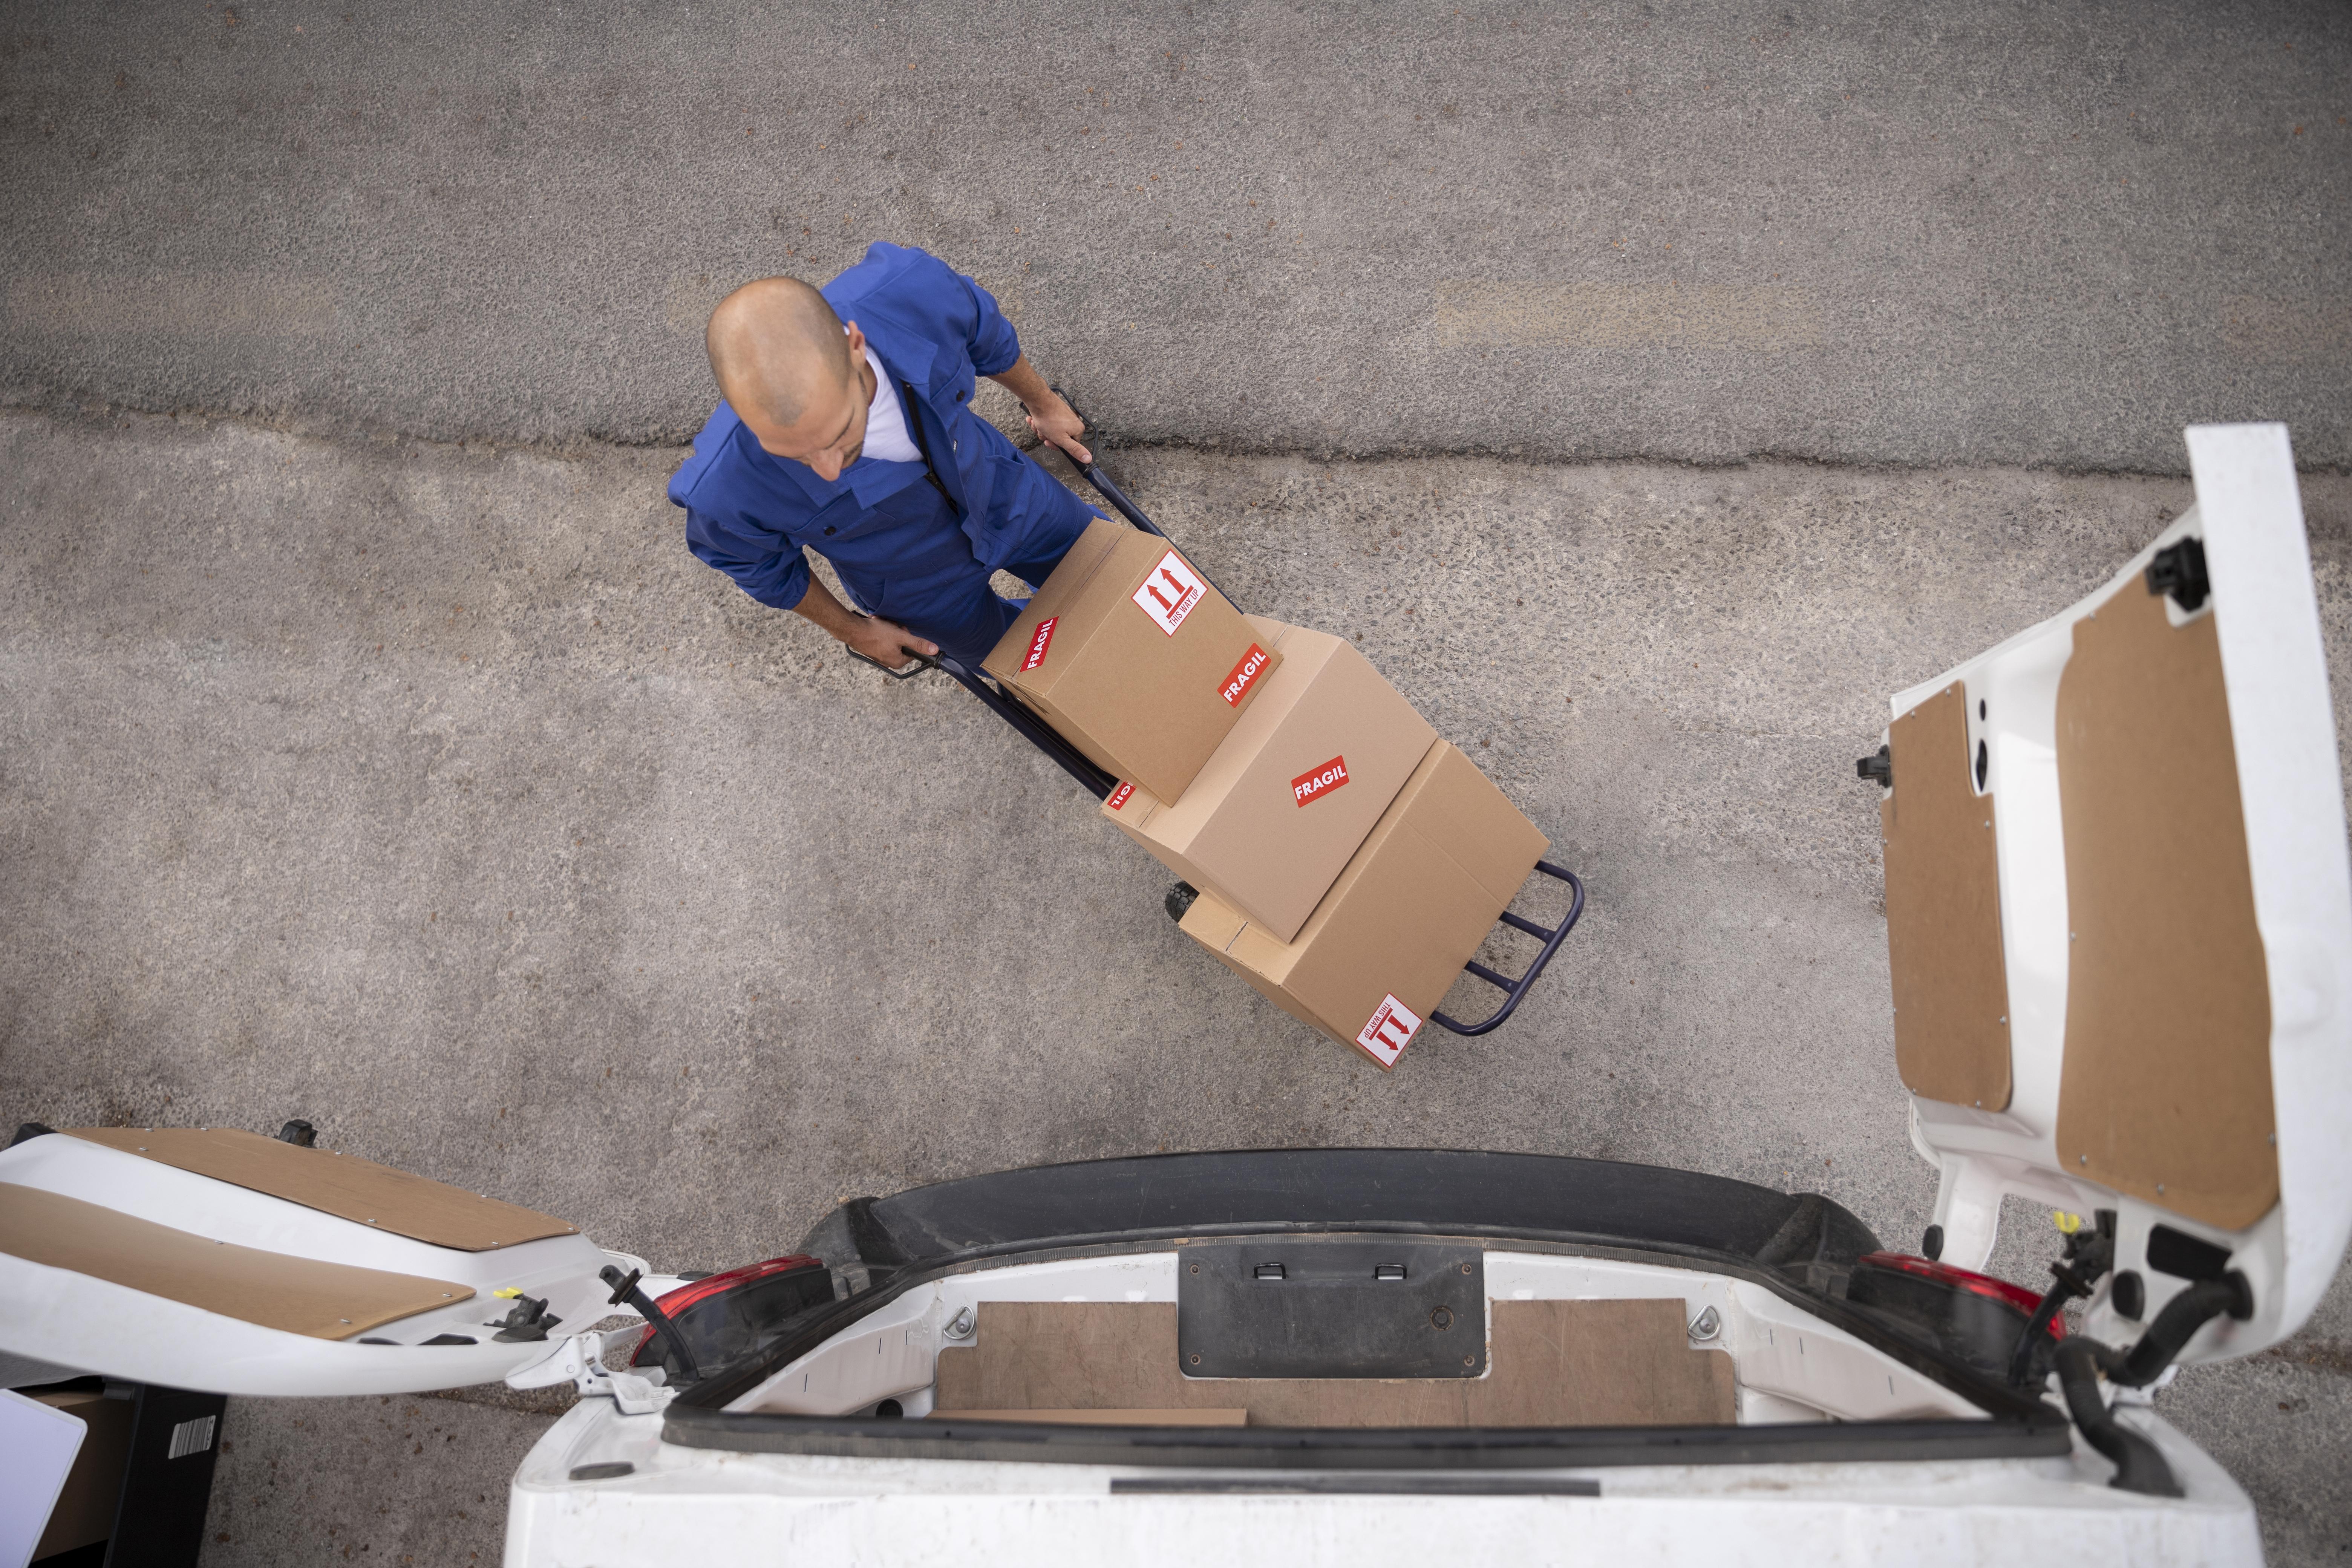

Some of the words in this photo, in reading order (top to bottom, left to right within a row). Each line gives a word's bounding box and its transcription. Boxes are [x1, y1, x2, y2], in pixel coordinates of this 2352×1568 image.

[1168, 611, 1182, 626] THIS
[1179, 597, 1192, 613] WAY
[1190, 589, 1199, 600] UP
[1027, 619, 1054, 669] FRAGIL
[1223, 652, 1266, 702] FRAGIL
[1111, 782, 1133, 805] GIL
[1294, 765, 1346, 800] FRAGIL
[1369, 1015, 1381, 1030] WAY
[1378, 1002, 1391, 1016] THIS
[1364, 1028, 1372, 1038] UP
